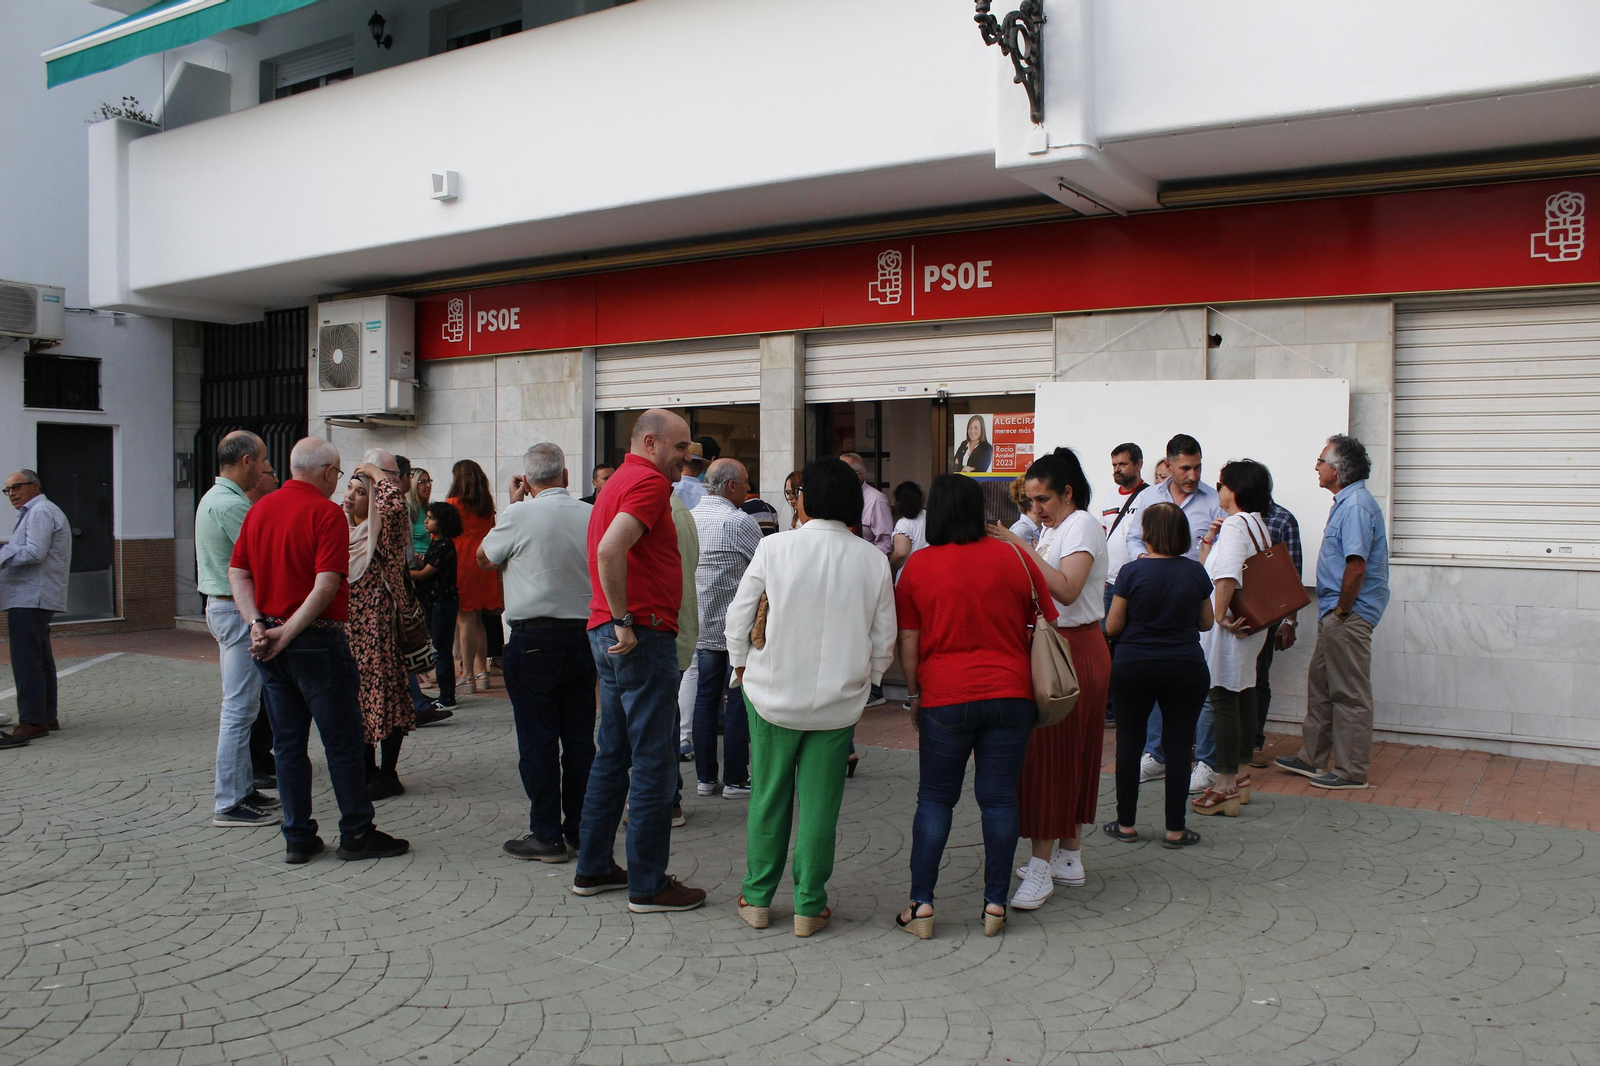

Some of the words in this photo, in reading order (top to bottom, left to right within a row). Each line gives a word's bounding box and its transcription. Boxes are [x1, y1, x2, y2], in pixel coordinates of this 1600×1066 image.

[924, 260, 993, 293] PSOE
[477, 307, 520, 333] PSOE
[995, 417, 1035, 425] ALGECIRA
